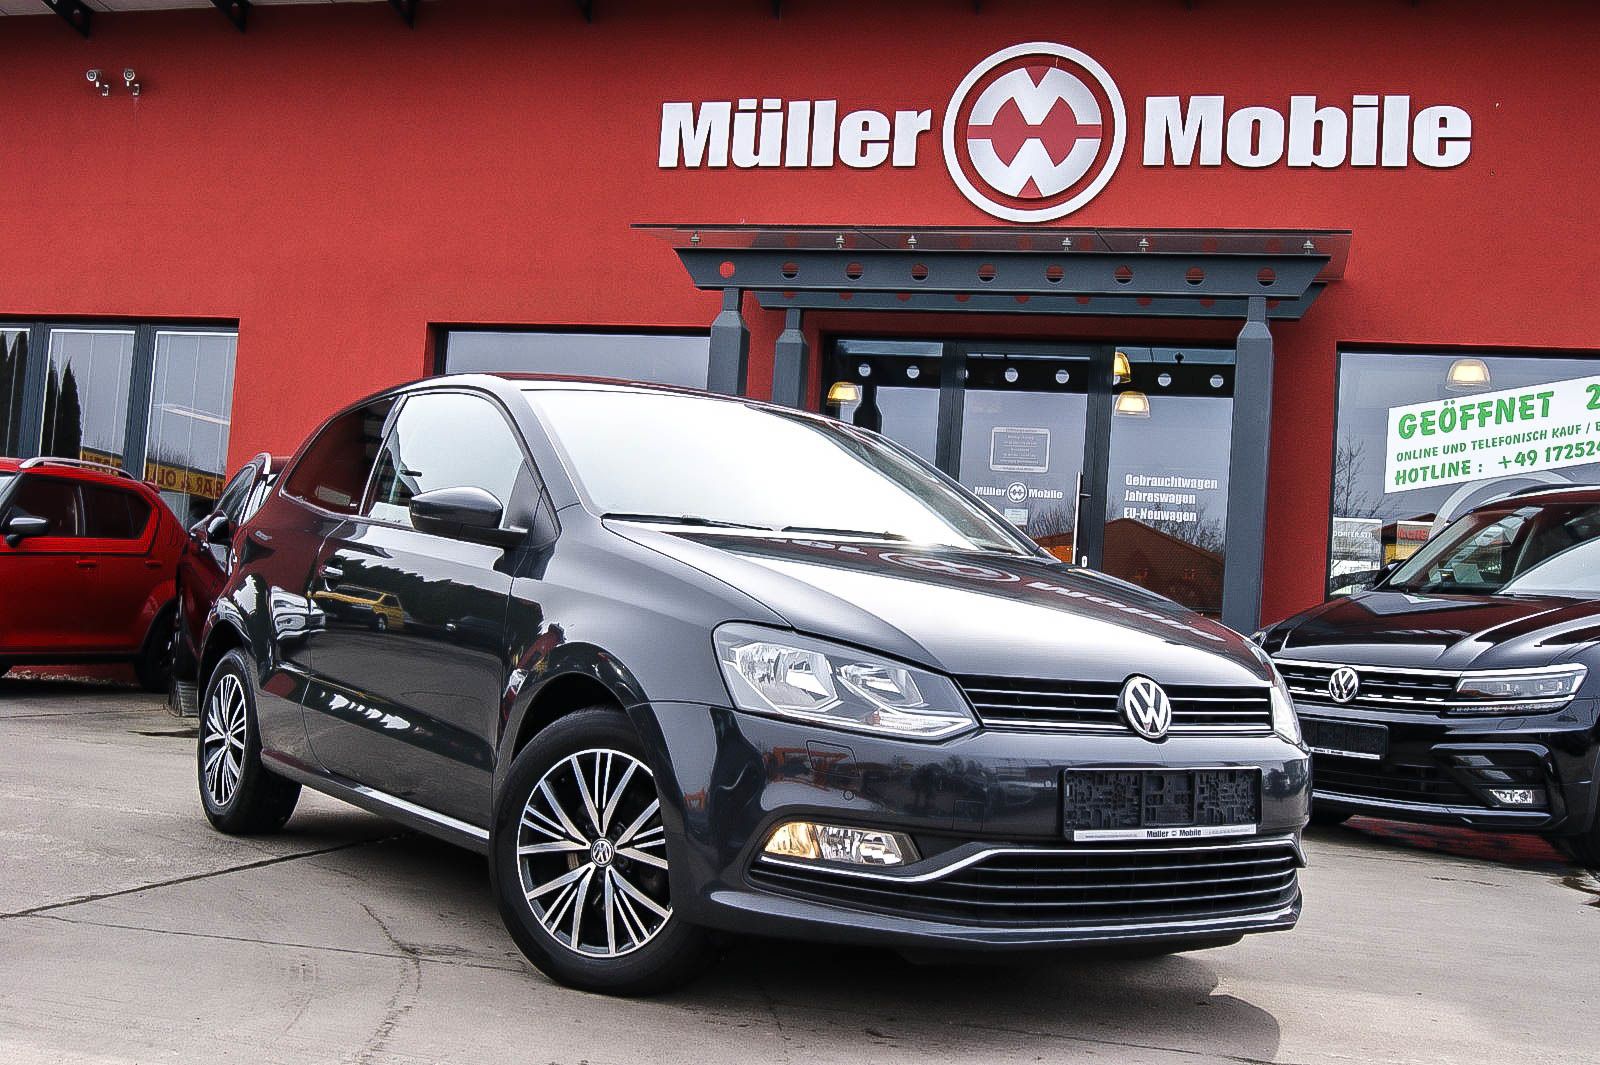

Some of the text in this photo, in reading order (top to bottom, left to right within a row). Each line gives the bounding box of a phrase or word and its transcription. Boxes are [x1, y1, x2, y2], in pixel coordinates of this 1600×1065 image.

[658, 98, 932, 168] Müller
[1142, 95, 1472, 168] Mobile
[1398, 391, 1555, 440] GEÖFFNET
[1396, 446, 1439, 463] ONLINE
[1442, 442, 1467, 455] UND
[1471, 429, 1548, 451] TELEFONISCH
[1552, 424, 1582, 439] KAUF
[1395, 460, 1471, 485] HOTLINE
[1498, 450, 1538, 469] +49
[1125, 474, 1218, 489] Gebrauchtwagen
[1124, 490, 1196, 504] Jahreswagen
[1123, 507, 1197, 522] EU-Neuwagen
[1179, 828, 1202, 837] Mobile
